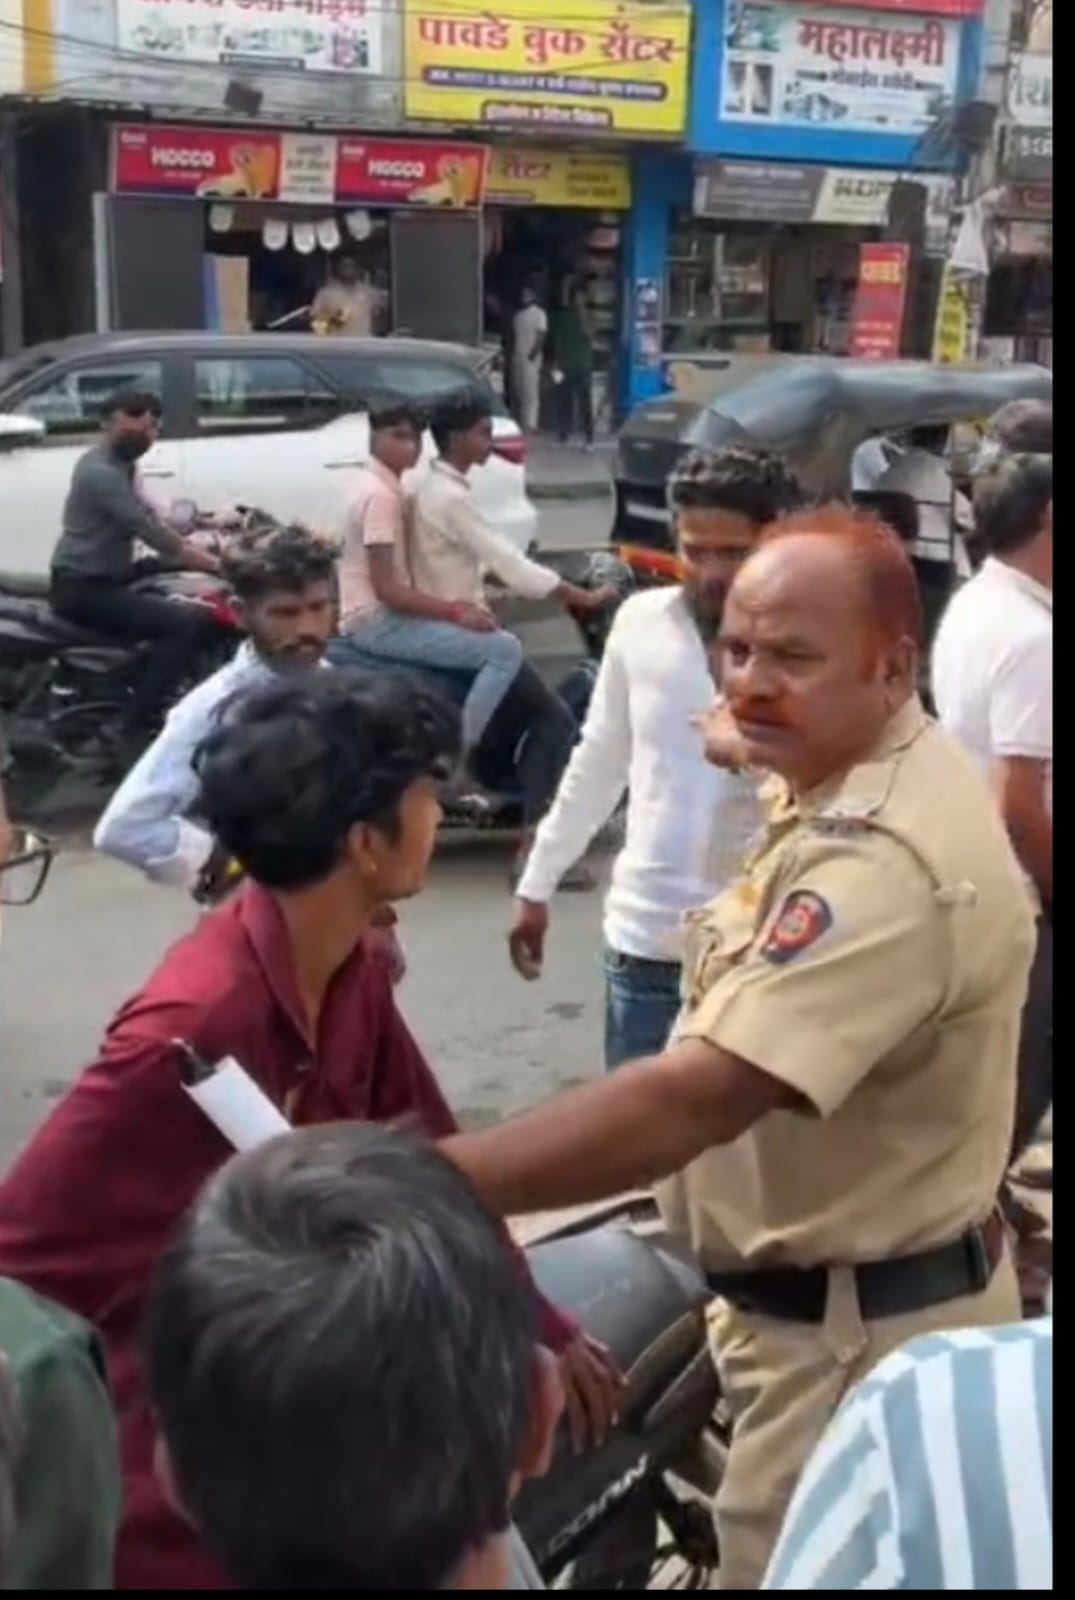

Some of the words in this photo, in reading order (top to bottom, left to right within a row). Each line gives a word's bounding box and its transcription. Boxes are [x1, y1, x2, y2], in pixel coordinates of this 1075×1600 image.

[418, 13, 510, 50] पावडे
[524, 25, 586, 64] बुक
[798, 19, 944, 66] महालक्ष्मी
[152, 147, 215, 168] HOCCO
[368, 159, 425, 178] HOCCO
